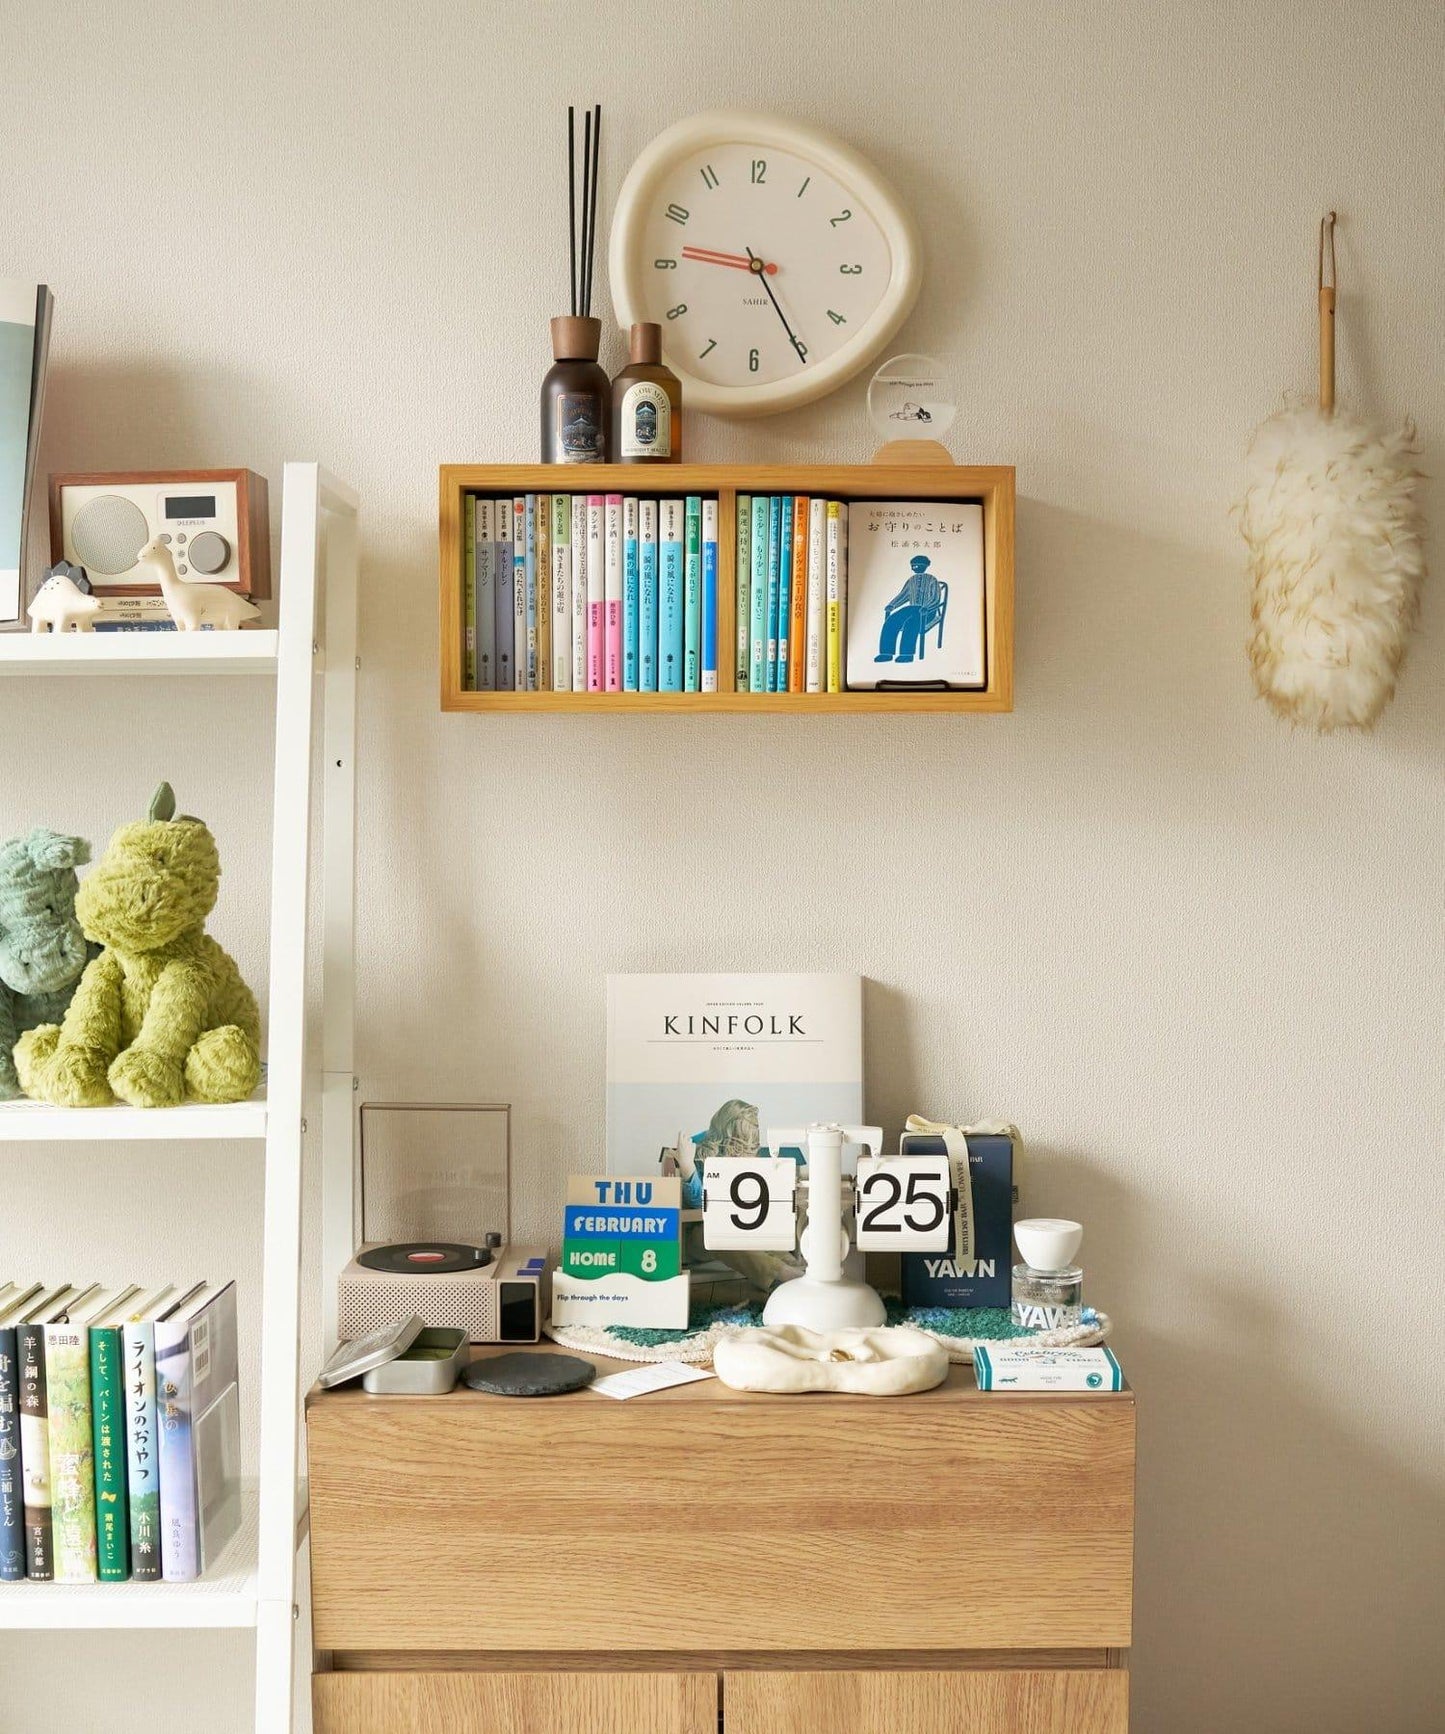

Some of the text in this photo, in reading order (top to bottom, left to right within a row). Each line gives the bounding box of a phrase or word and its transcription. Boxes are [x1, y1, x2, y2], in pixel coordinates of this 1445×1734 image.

[700, 165, 719, 190] 11
[751, 160, 766, 184] 12
[797, 177, 810, 198] 1
[665, 203, 690, 226] 10
[829, 209, 852, 228] 2
[654, 259, 677, 270] 9
[839, 264, 862, 274] 3
[666, 304, 688, 320] 8
[742, 298, 769, 306] SAHIR
[826, 309, 847, 326] 4
[699, 338, 718, 359] 7
[749, 348, 759, 372] 6
[868, 521, 963, 533] お守りのことば
[756, 506, 764, 577] あと少し、もう少し
[481, 549, 489, 586] サブマリン
[500, 549, 508, 586] チルドレン
[644, 550, 652, 605] 一瞬の風になれ
[666, 549, 675, 603] 一瞬の風になれ
[556, 546, 565, 614] 神さまたちの遊ぶ庭
[664, 1014, 807, 1035] KINFOLK
[594, 1181, 653, 1205] THU
[730, 1171, 770, 1231] 9
[862, 1172, 945, 1232] 25
[574, 1216, 668, 1234] FEBRUARY
[570, 1249, 657, 1273] HOME 8
[924, 1259, 995, 1278] YAWN
[557, 1293, 569, 1302] Flip
[570, 1293, 598, 1302] through
[611, 1294, 629, 1302] days
[48, 1335, 81, 1346] 恩田陸
[24, 1336, 44, 1567] 羊と鋼の森 宮下奈都
[97, 1341, 114, 1559] そして、バトンは渡された 瀬尾まいこ
[132, 1341, 151, 1554] ライオンのおやつ 小川糸
[1, 1468, 15, 1527] 三浦しをん
